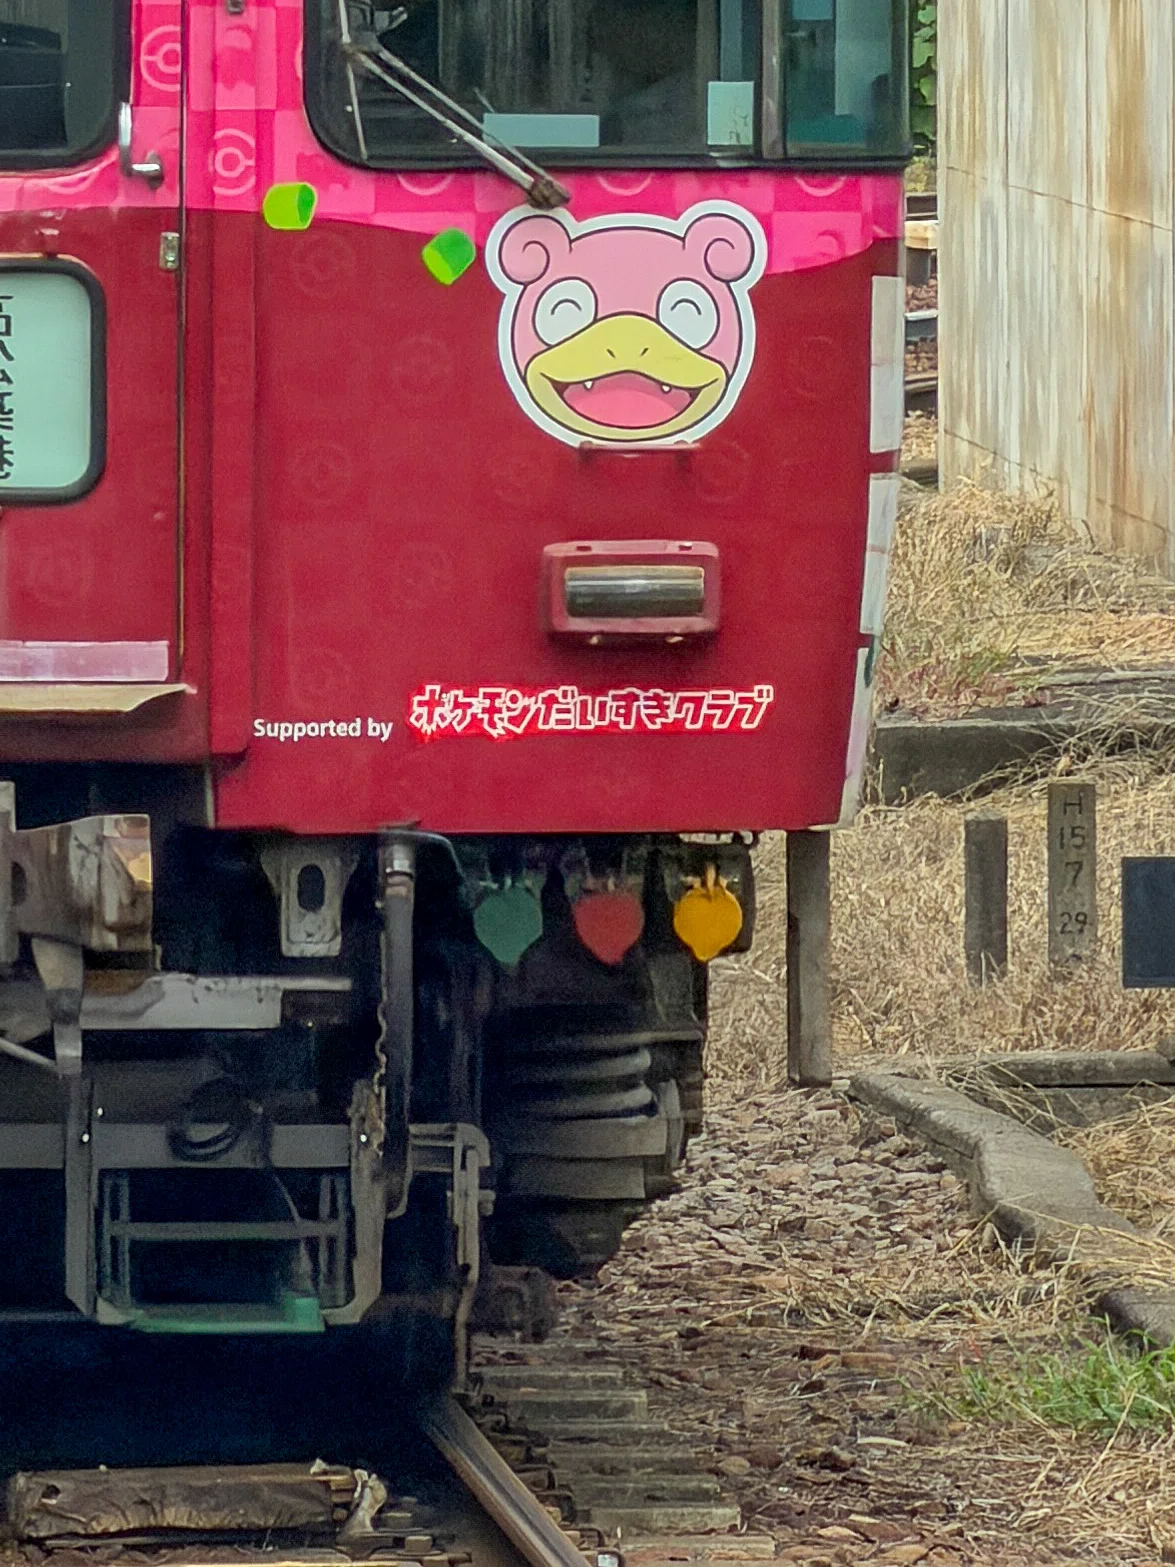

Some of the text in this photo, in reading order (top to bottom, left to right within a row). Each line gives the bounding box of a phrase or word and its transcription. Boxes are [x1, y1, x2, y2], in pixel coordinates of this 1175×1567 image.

[253, 684, 775, 743] Supported by ポケモンだいすきクラブ
[1063, 793, 1083, 816] H
[1059, 825, 1086, 850] 15
[1064, 860, 1084, 886] 7
[1059, 911, 1088, 935] 29
